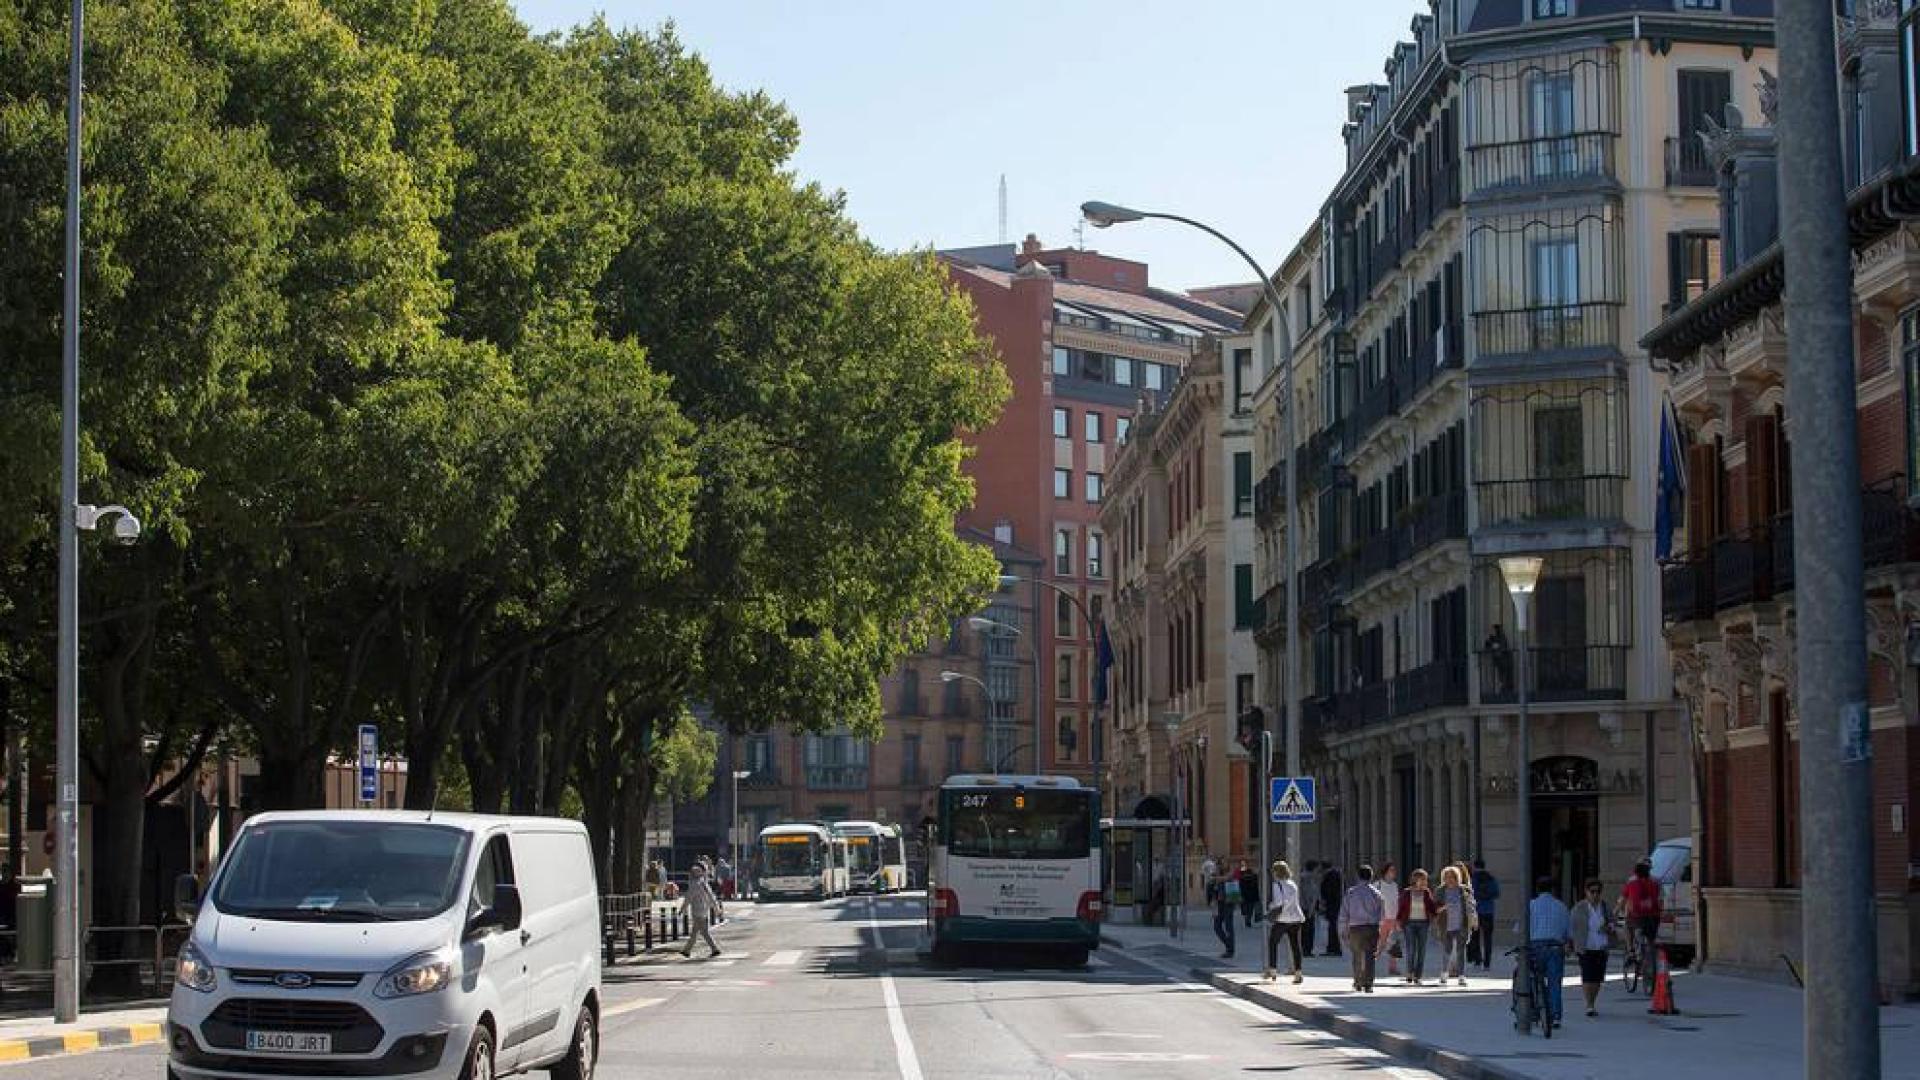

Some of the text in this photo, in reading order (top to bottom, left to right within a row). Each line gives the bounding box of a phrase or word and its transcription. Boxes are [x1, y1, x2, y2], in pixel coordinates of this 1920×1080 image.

[963, 794, 988, 808] 247
[257, 1033, 327, 1050] 8400 JRT
